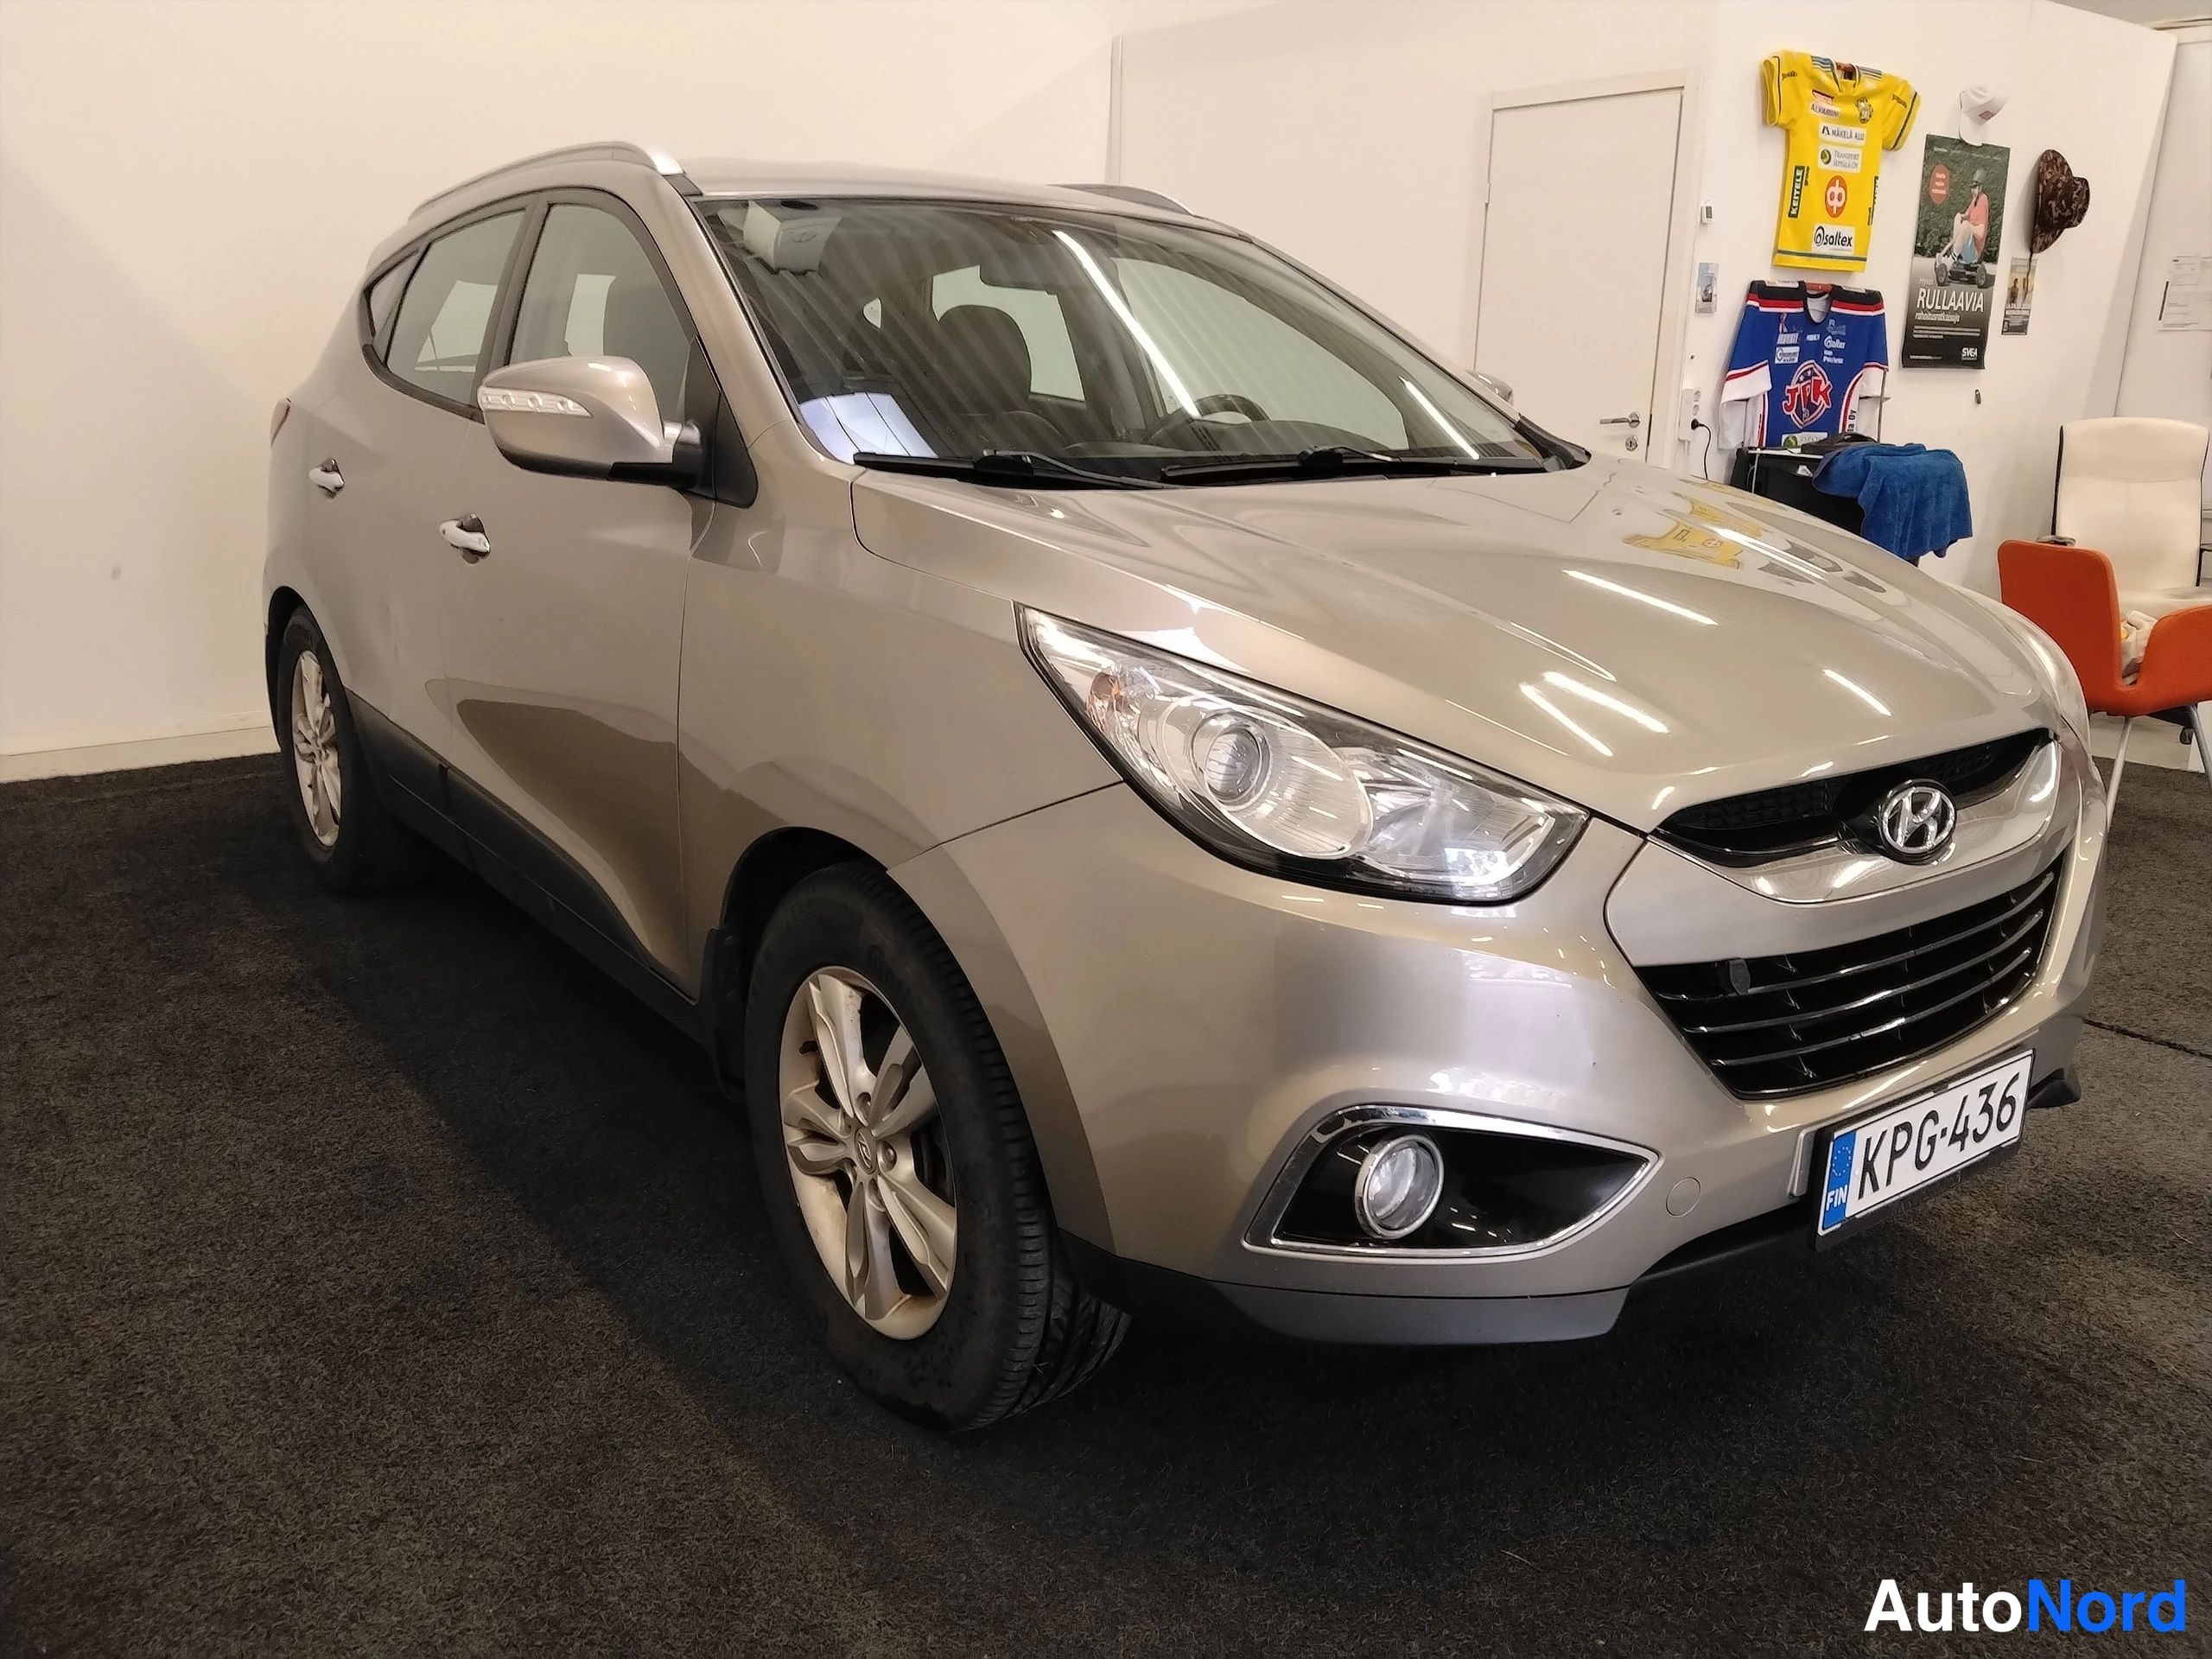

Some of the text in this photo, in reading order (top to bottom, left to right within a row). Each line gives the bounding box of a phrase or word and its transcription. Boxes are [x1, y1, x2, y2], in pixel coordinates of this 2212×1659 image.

[1790, 168, 1803, 215] KEITELE
[1916, 288, 1984, 312] RULLAAVIA
[1961, 347, 1978, 357] SVEA
[1858, 1071, 2019, 1200] KPG-436
[1825, 1185, 1849, 1211] FIN
